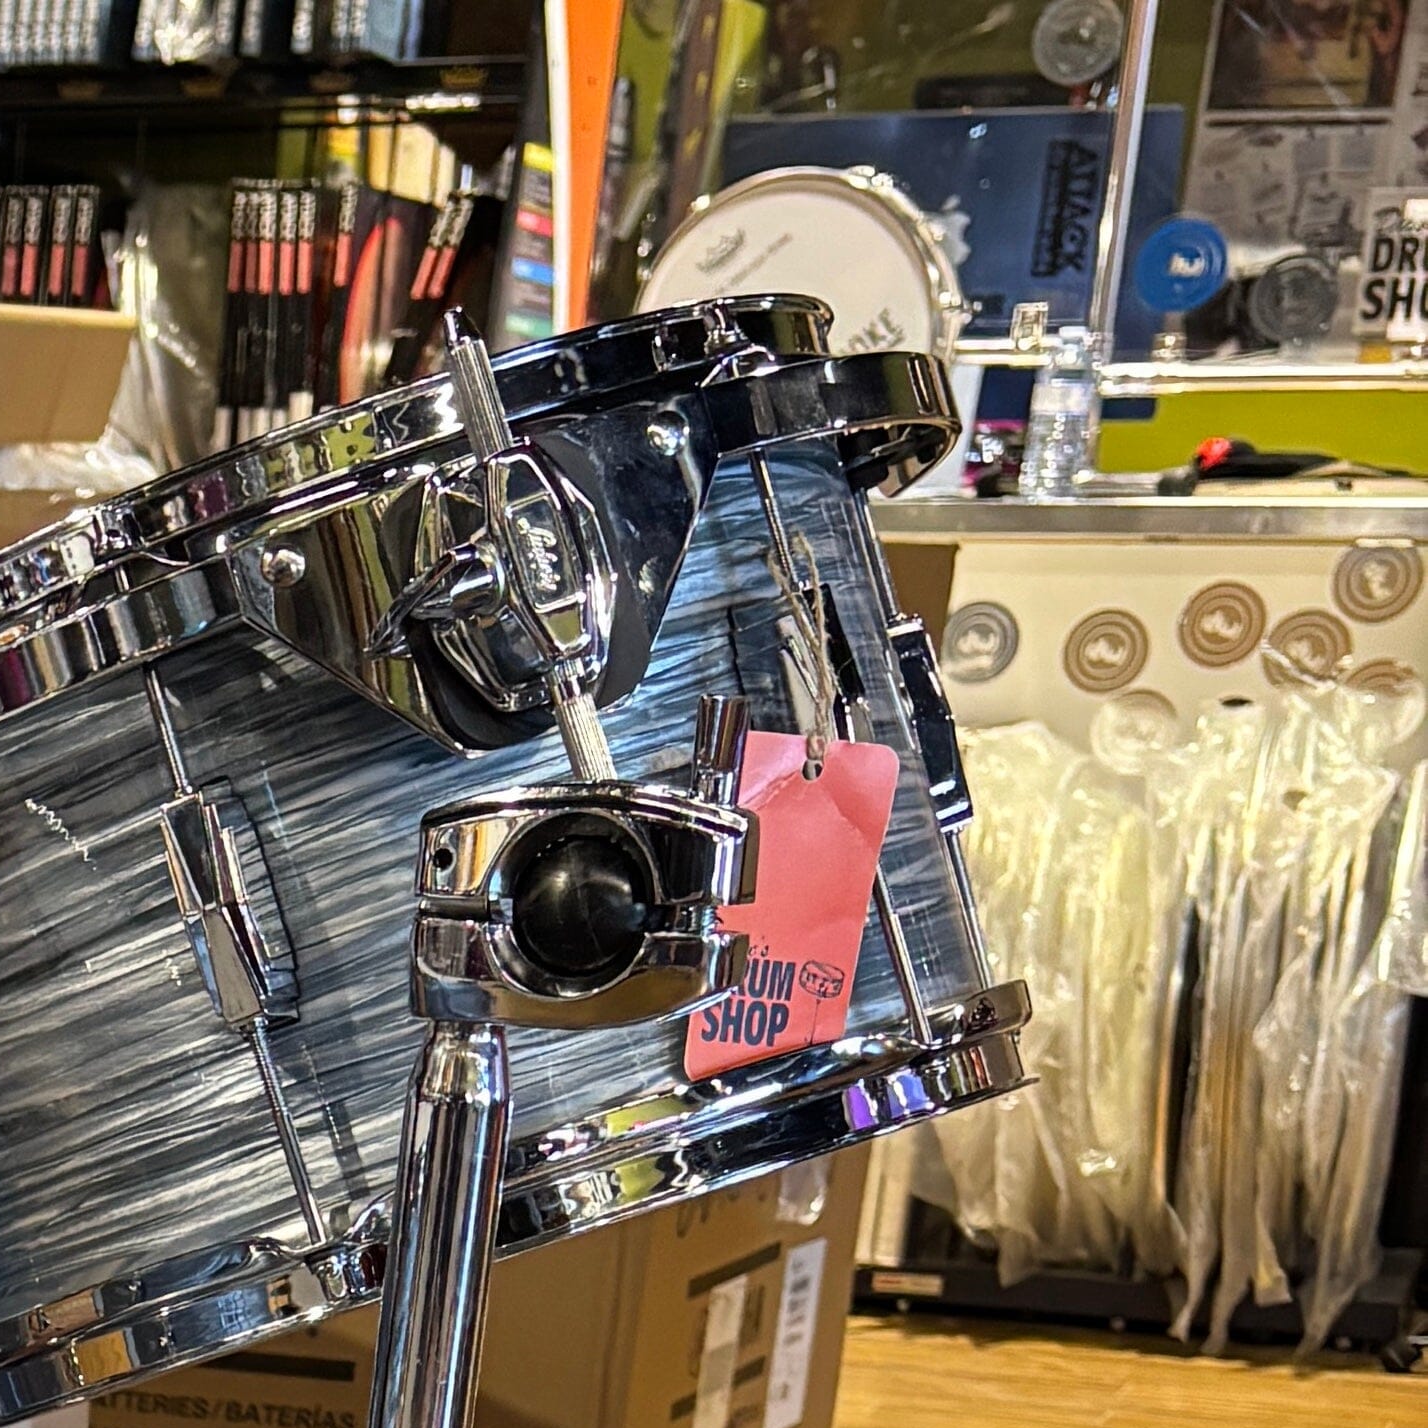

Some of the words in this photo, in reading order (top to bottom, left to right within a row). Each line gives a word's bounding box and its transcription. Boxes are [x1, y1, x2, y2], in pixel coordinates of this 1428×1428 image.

[1059, 141, 1099, 273] ATTACK
[1371, 236, 1428, 273] DR
[701, 1000, 790, 1048] SHOP
